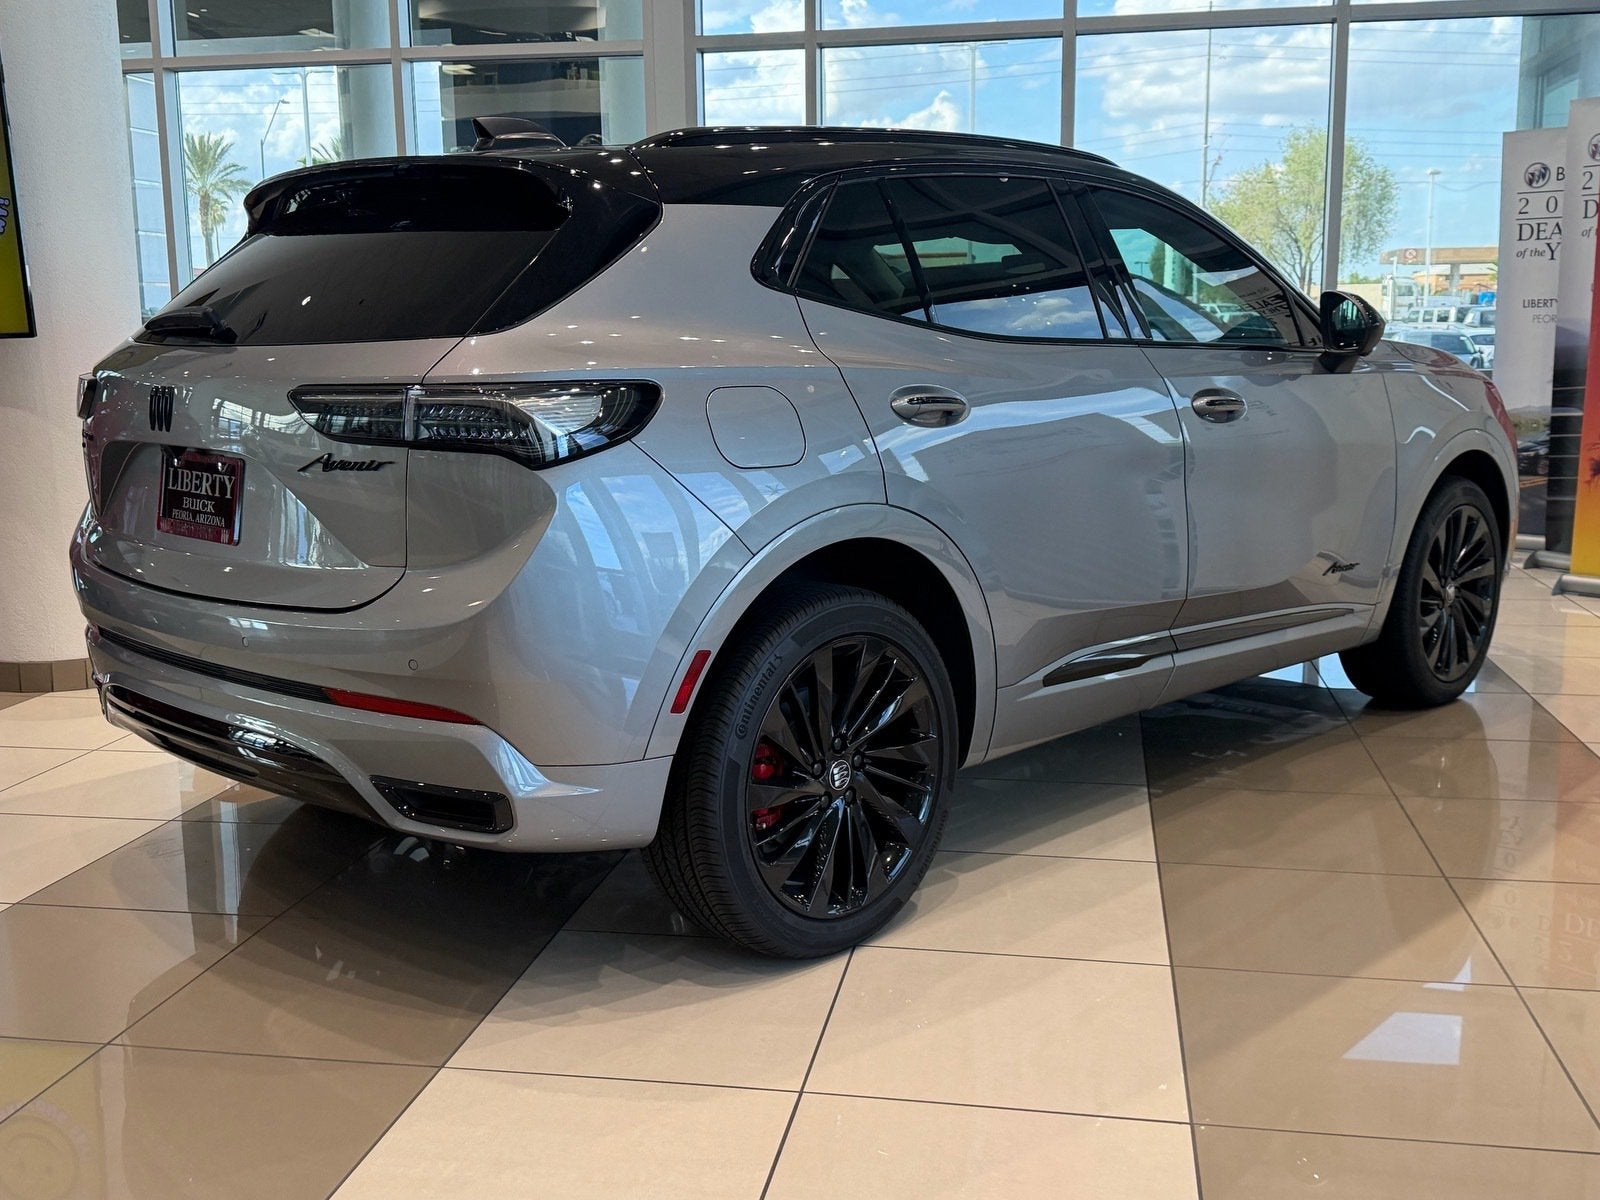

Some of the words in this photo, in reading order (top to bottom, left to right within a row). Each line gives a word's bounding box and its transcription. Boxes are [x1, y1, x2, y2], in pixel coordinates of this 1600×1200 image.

[1516, 247, 1529, 259] of
[1529, 247, 1546, 257] the
[297, 452, 396, 472] Avenir
[168, 467, 236, 499] LIBERTY
[182, 496, 215, 513] BUICK
[195, 513, 225, 528] ARIZONA
[734, 659, 778, 740] Continental
